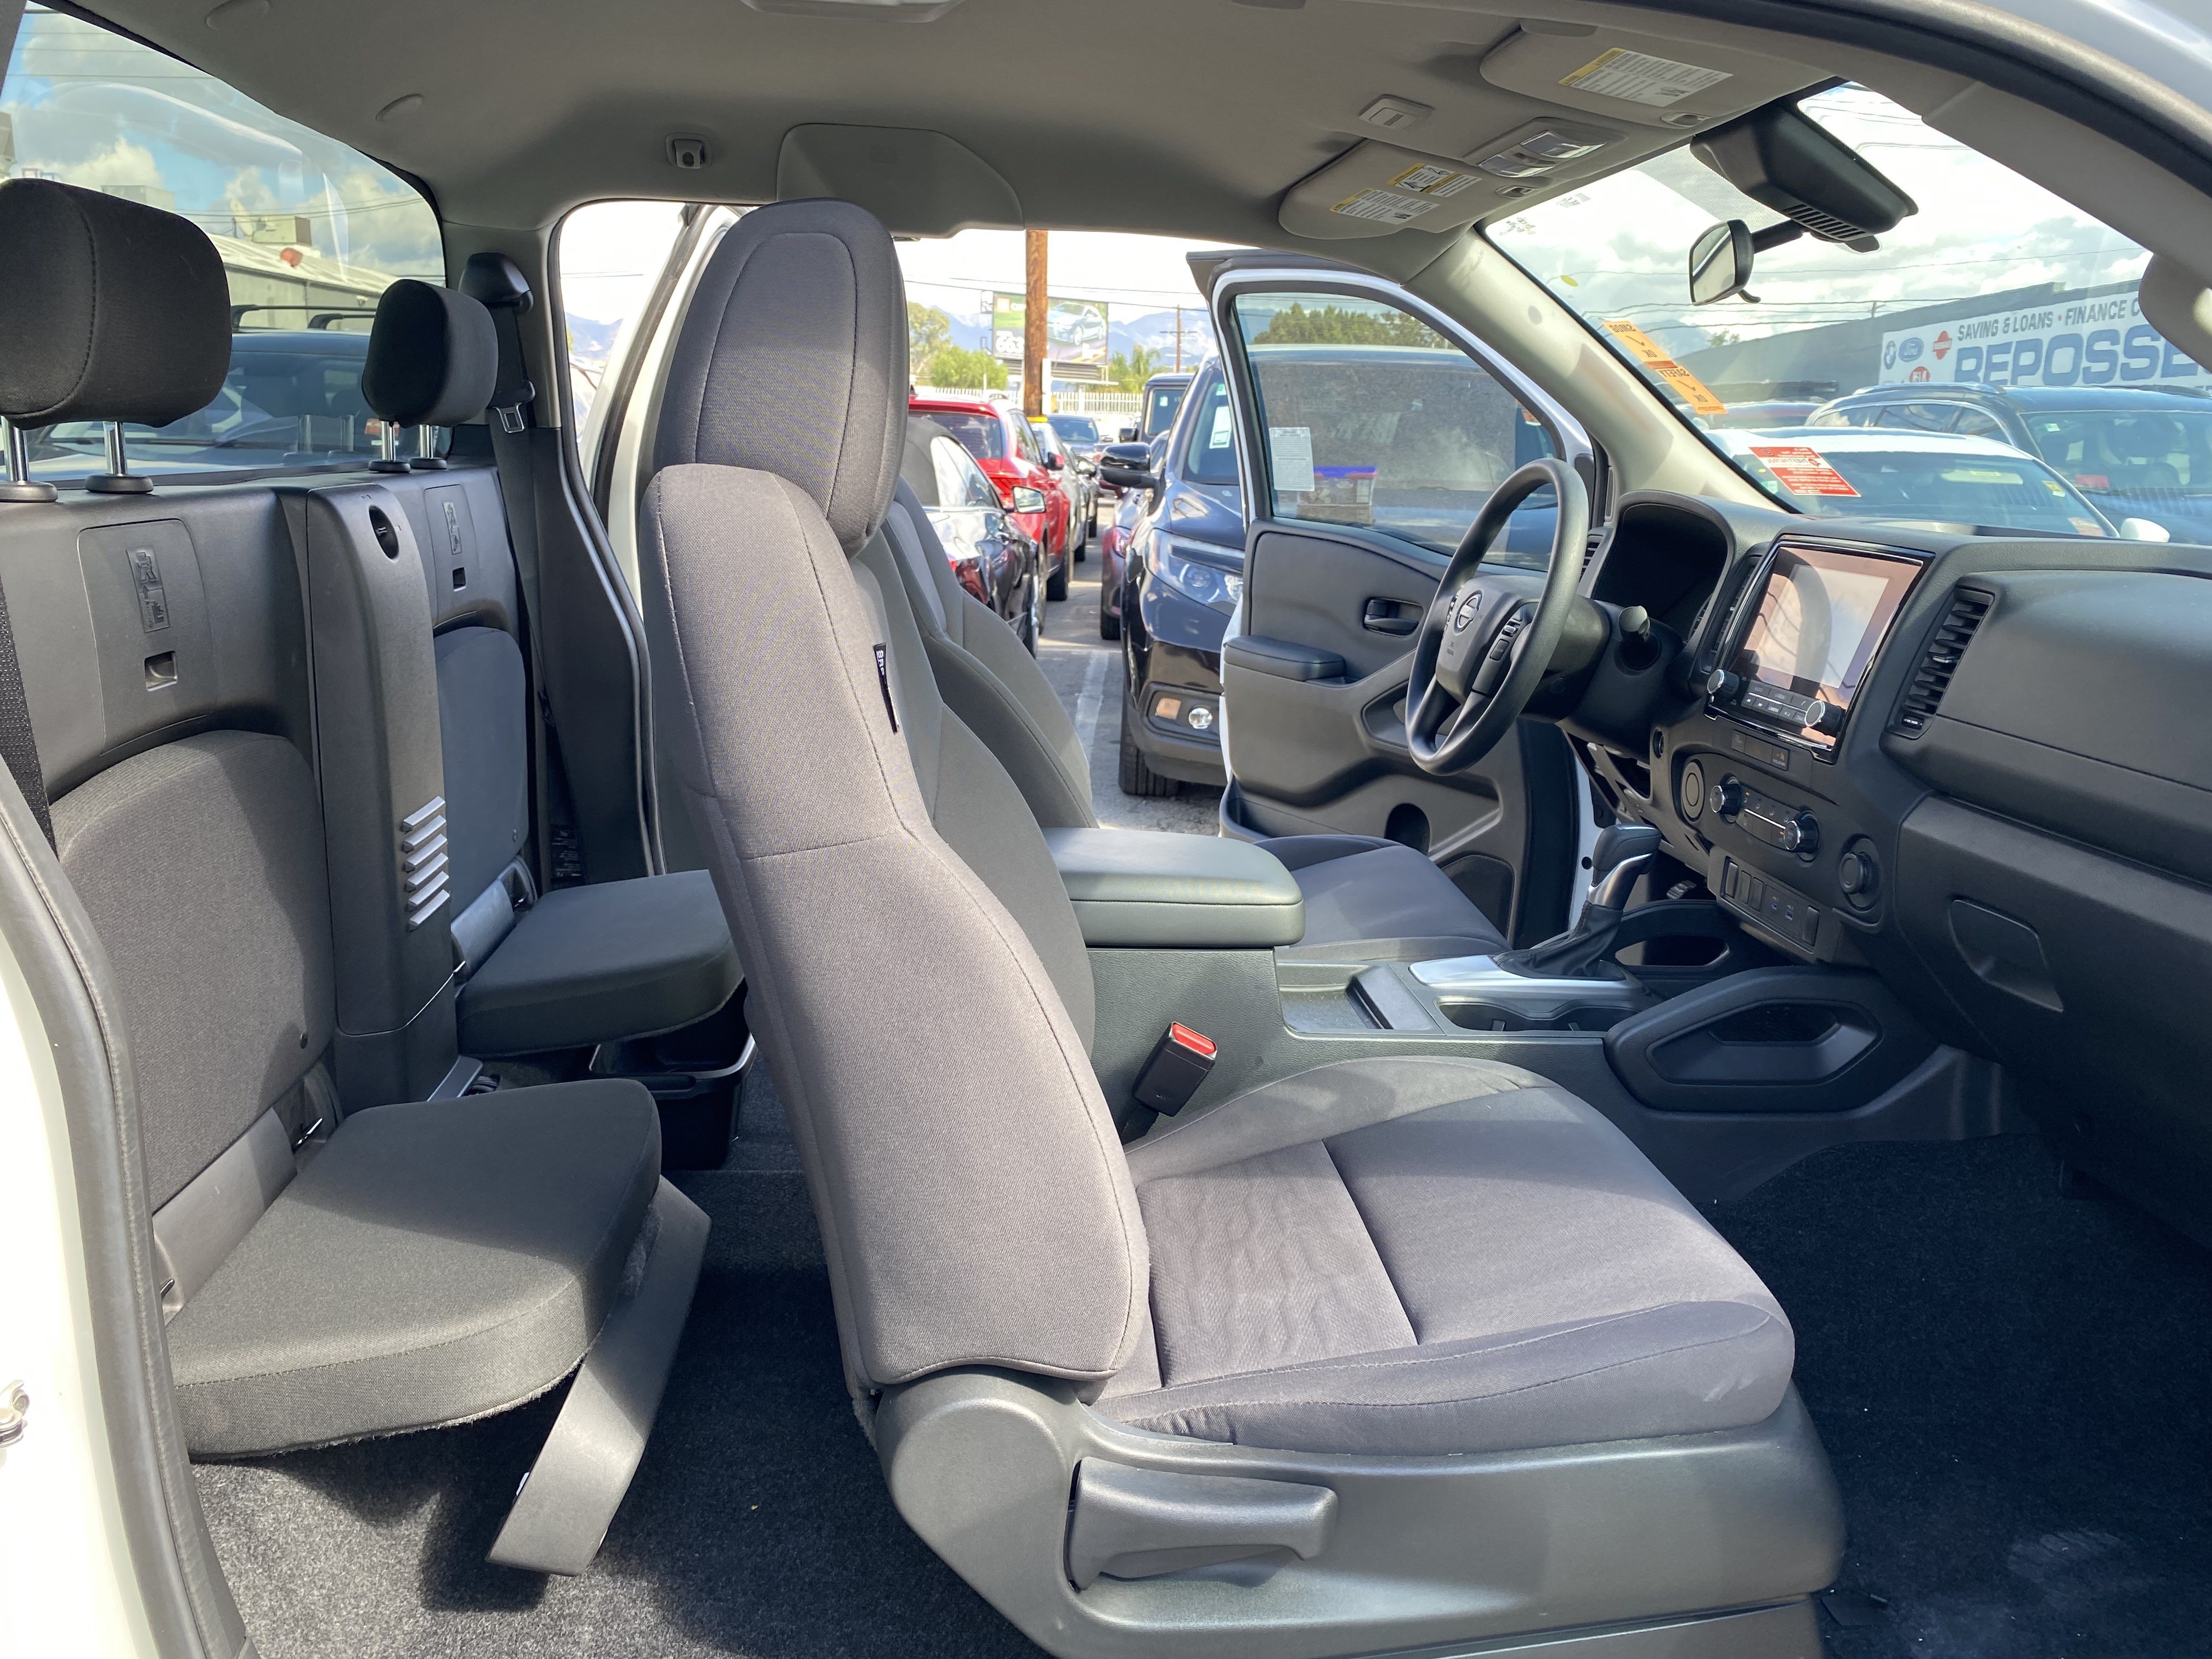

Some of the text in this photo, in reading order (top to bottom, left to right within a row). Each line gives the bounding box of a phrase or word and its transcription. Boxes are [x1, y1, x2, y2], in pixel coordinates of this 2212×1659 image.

[1957, 319, 1999, 341] SAVING
[2002, 317, 2011, 334] &
[2012, 311, 2053, 333] LOANS
[2065, 300, 2128, 325] FINANCE
[1955, 324, 2212, 385] REPOSSE
